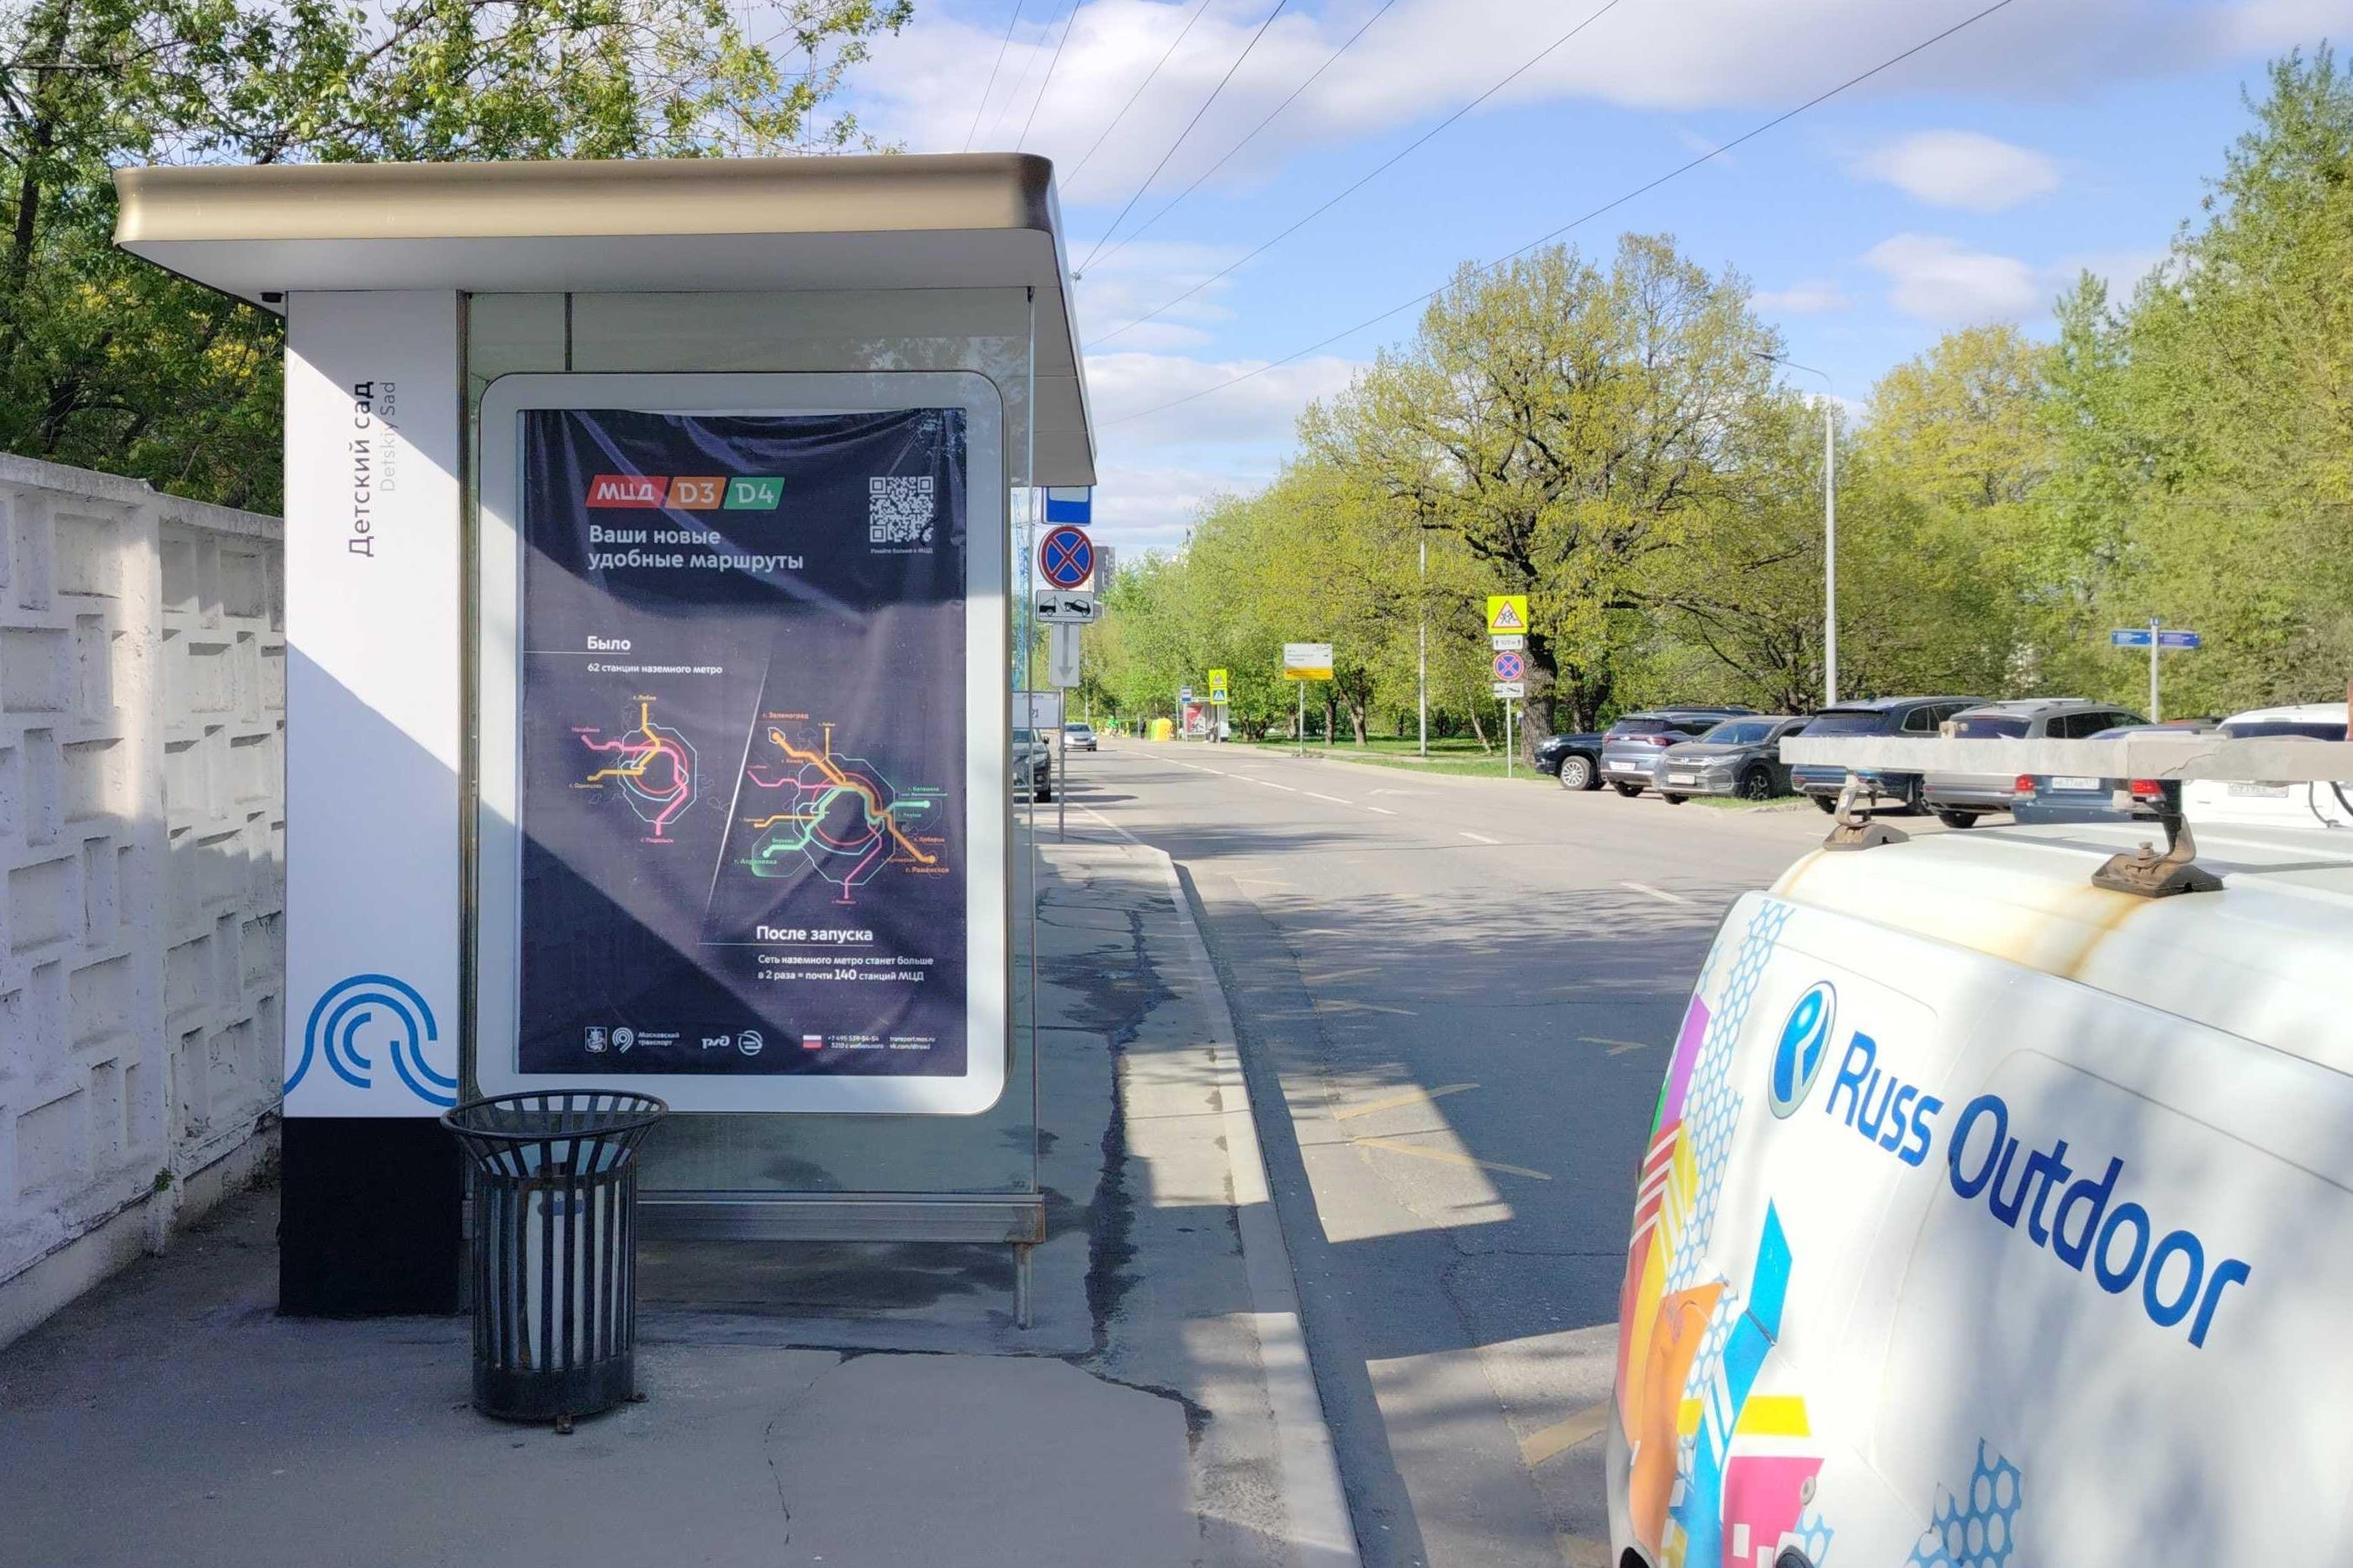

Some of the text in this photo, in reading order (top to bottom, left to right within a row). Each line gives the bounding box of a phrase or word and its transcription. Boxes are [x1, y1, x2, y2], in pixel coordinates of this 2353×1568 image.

[379, 382, 399, 492] Detskiy Sad
[349, 381, 374, 557] Детский сад
[596, 483, 775, 504] МЦД D3 D4
[590, 525, 721, 544] Ваши новые
[588, 549, 803, 573] удобные маршруты
[587, 636, 631, 651] Было
[587, 663, 722, 675] 62 станции наземного метро
[757, 926, 873, 943] После запуска
[758, 954, 933, 967] Сеть наземного метро станет больше
[765, 970, 772, 979] 2
[774, 972, 796, 980] раза
[806, 972, 833, 980] почти
[834, 969, 857, 980] 140
[859, 971, 896, 981] станций
[898, 971, 924, 982] МЦД
[1826, 1031, 2252, 1349] Russ Outdoor
